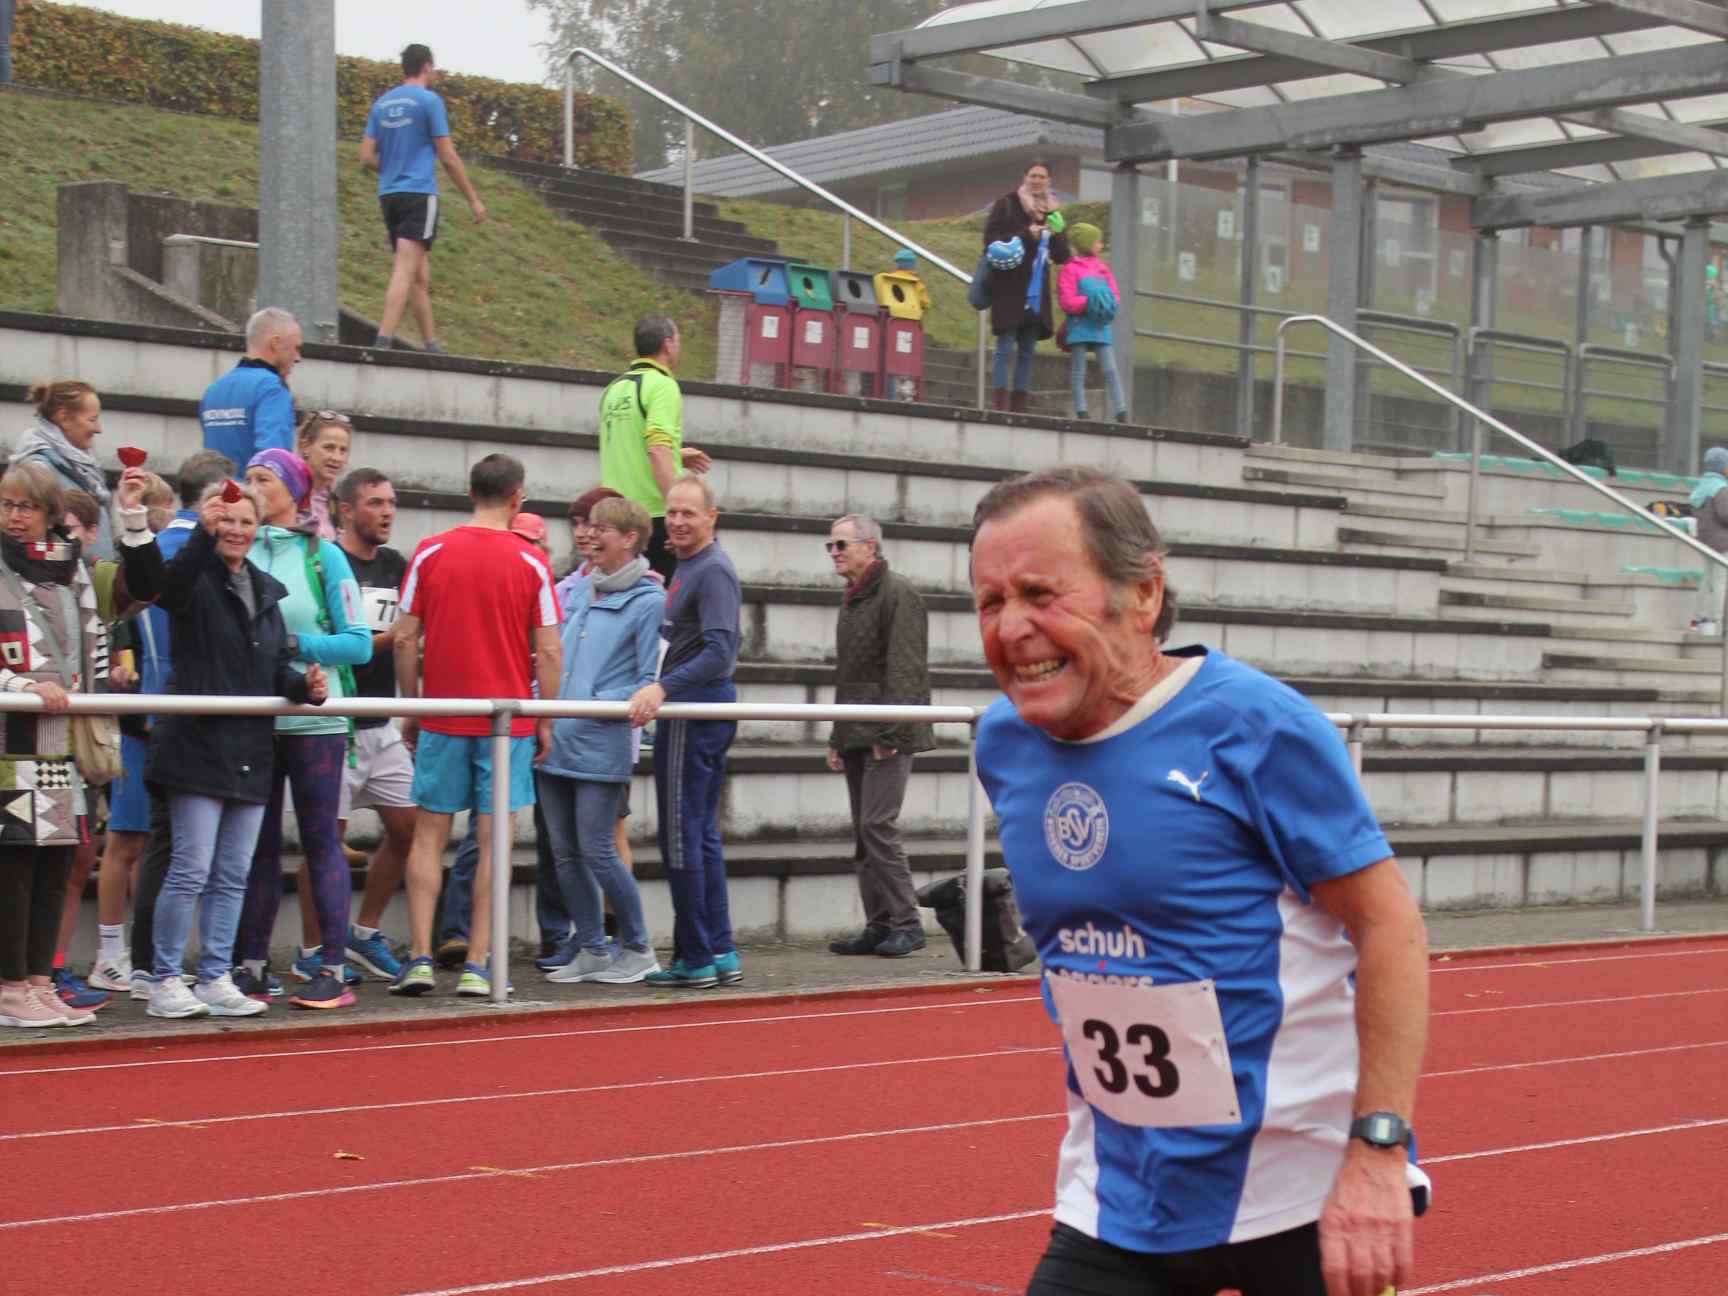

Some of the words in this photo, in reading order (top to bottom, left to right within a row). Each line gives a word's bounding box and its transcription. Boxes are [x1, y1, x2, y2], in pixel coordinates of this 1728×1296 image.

[1058, 808, 1091, 847] BSV
[1058, 921, 1146, 958] schuh
[1083, 1019, 1180, 1098] 33
